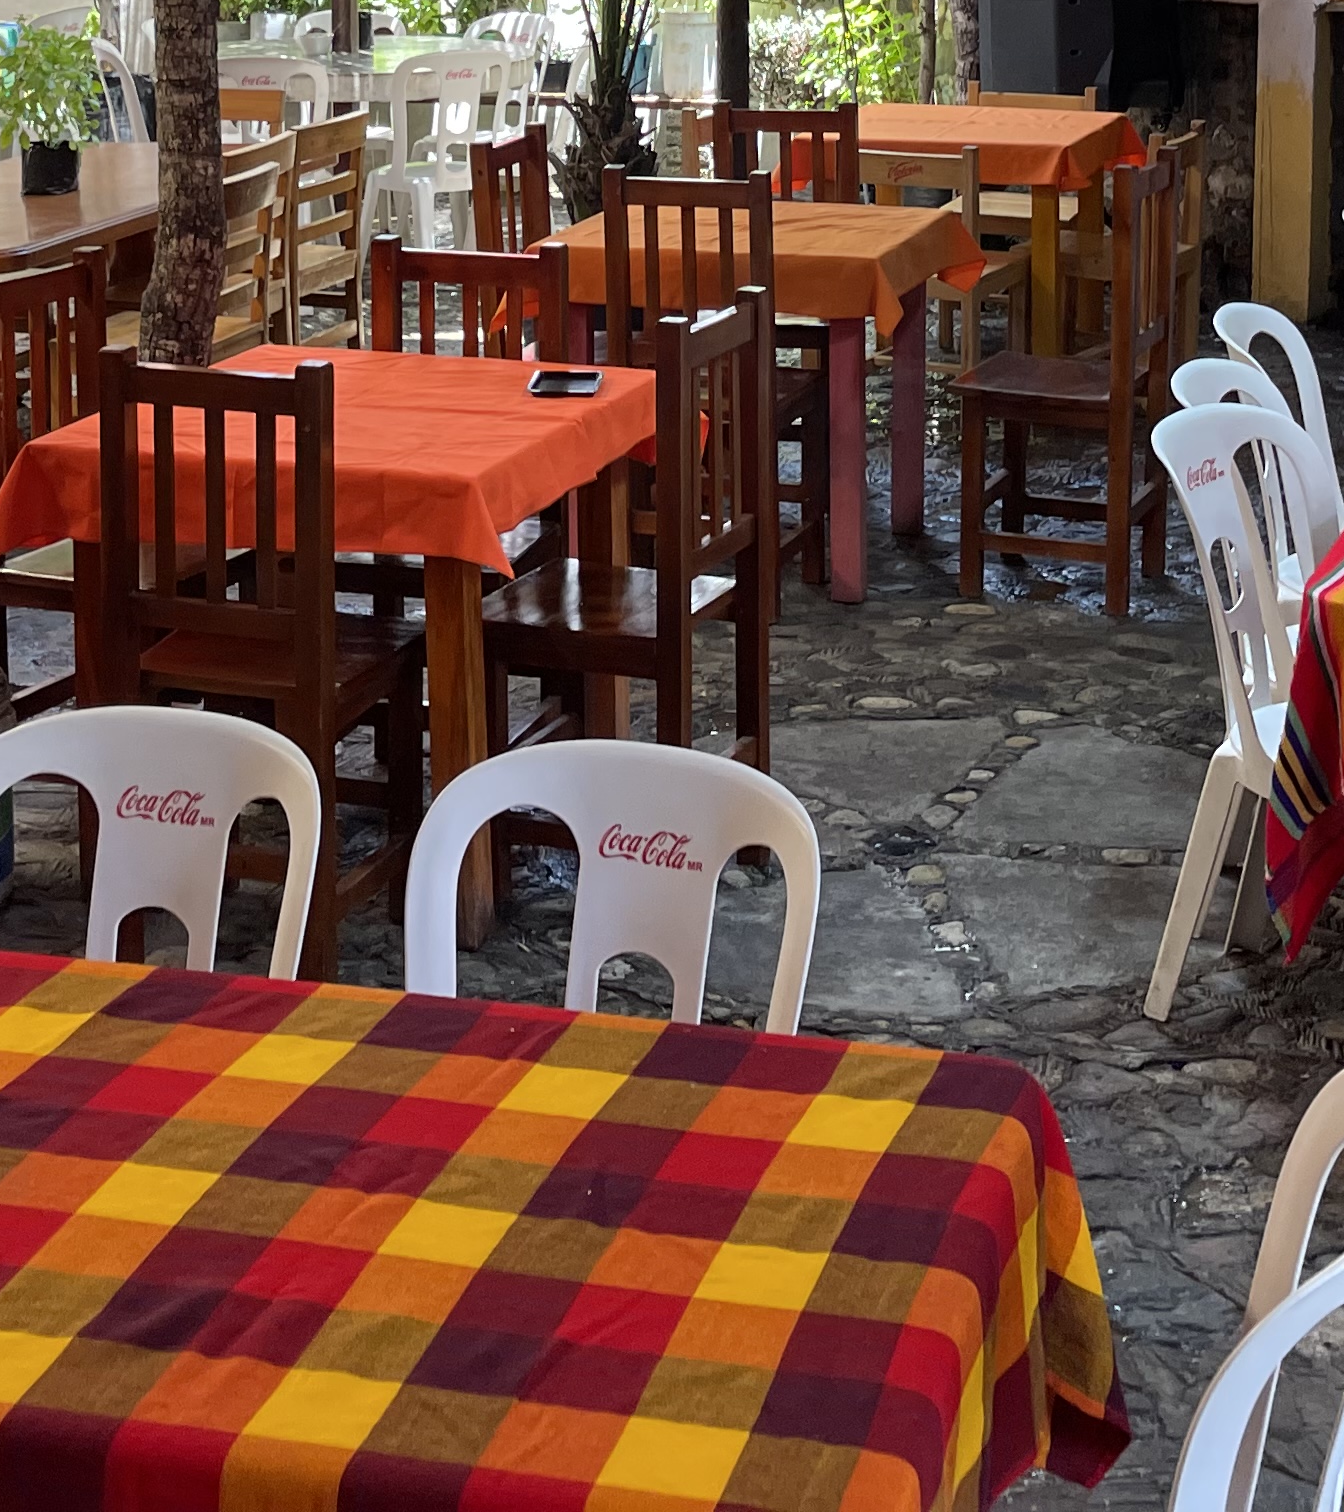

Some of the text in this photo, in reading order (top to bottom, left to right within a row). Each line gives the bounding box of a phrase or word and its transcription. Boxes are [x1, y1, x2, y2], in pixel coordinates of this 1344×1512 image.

[116, 785, 216, 828] Coca-Cola MR
[598, 824, 703, 872] Coca-Cola MR
